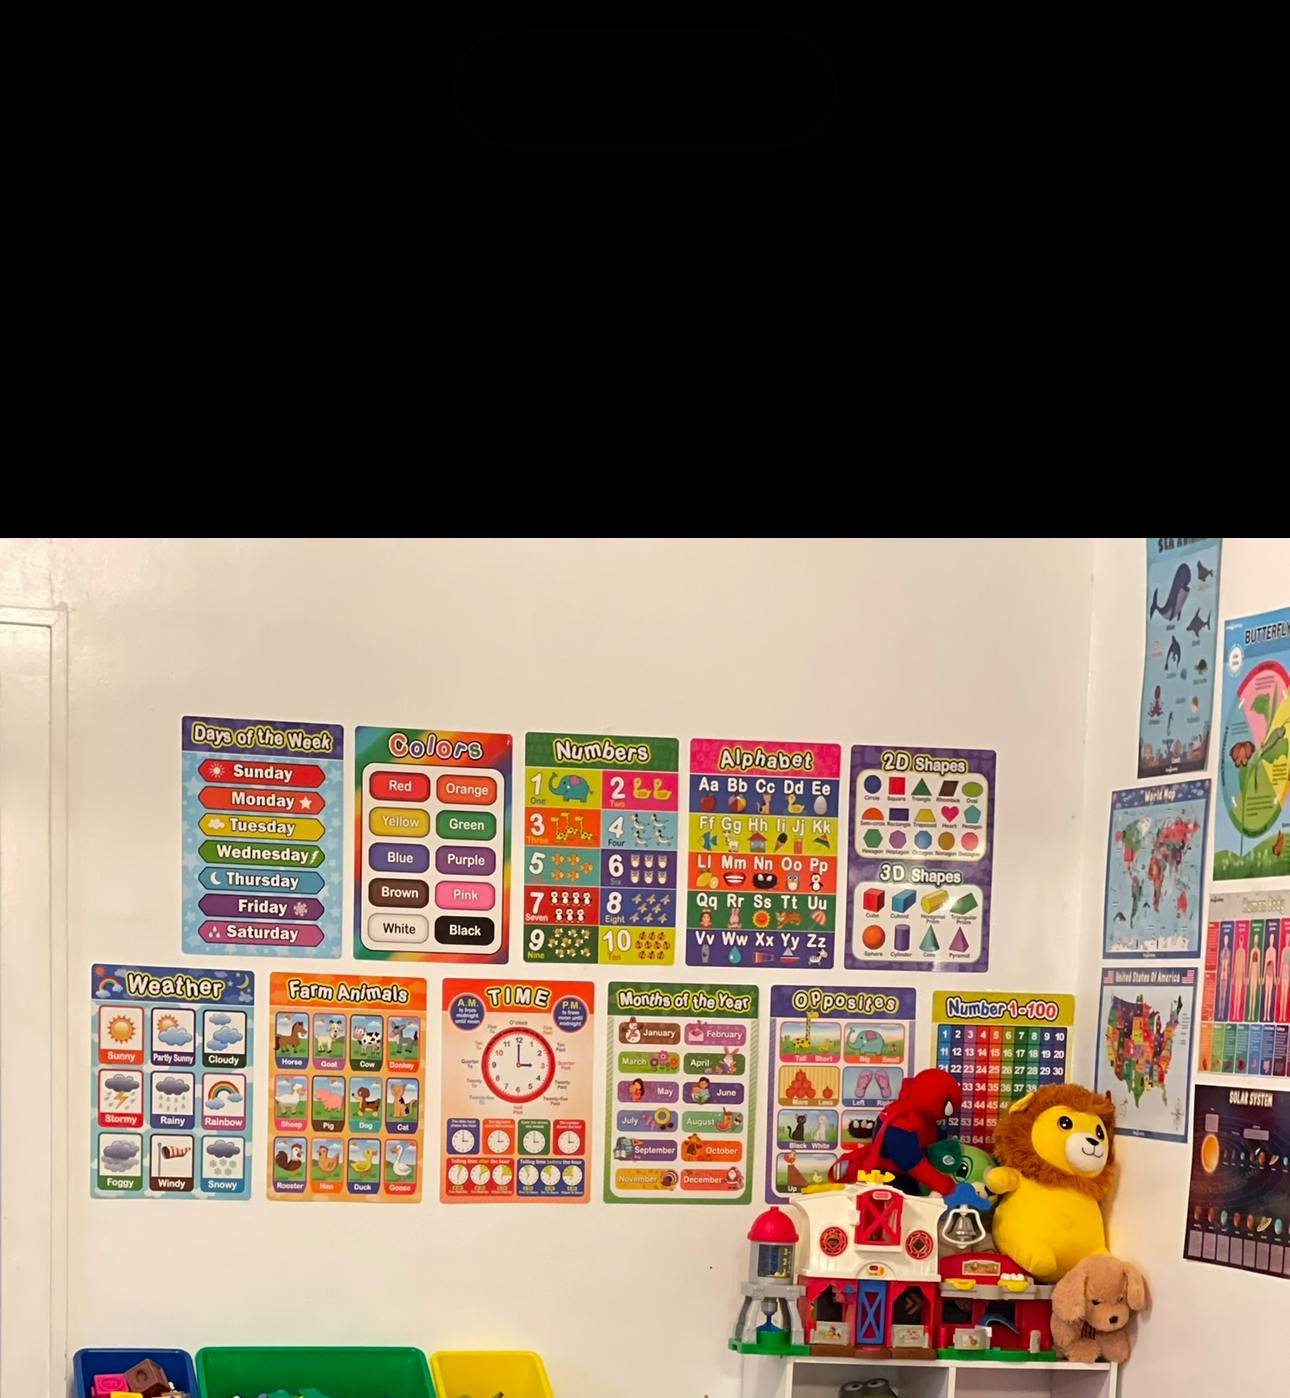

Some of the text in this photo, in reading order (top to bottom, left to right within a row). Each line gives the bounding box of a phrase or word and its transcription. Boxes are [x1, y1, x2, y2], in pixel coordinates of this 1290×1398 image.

[193, 724, 332, 752] Days of the Week
[389, 733, 482, 759] Colors
[555, 740, 649, 762] Numbers
[720, 747, 814, 770] Alphabet
[882, 752, 966, 774] 2D Shapes
[233, 764, 292, 783] Sunday
[388, 780, 412, 792] Red
[445, 783, 488, 796] Orange
[531, 773, 541, 795] 1
[610, 776, 626, 800] 2
[699, 777, 831, 795] Aa Bb Cc Dd Ee
[232, 791, 294, 810] Monday
[1144, 789, 1175, 802] World Map
[229, 818, 295, 837] Tuesday
[382, 816, 420, 828] Yellow
[449, 818, 485, 831] Green
[530, 813, 545, 836] 3
[609, 816, 624, 839] 4
[700, 817, 831, 836] Ff Gg Hh Ii Jj Kk
[608, 839, 625, 848] Four
[216, 844, 308, 864] Wednesday
[387, 851, 414, 864] Blue
[447, 854, 485, 868] Purple
[529, 852, 546, 874] 5
[608, 854, 623, 877] 6
[698, 856, 828, 874] Ll Mm Nn Oo Pp
[227, 872, 299, 890] Thursday
[880, 864, 961, 886] 3D Shapes
[381, 887, 419, 899] Brown
[453, 889, 479, 901] Pink
[530, 892, 544, 914] 7
[607, 891, 622, 915] 8
[697, 893, 827, 910] Qq Rr Ss Tt Uu
[238, 900, 287, 917] Friday
[525, 913, 549, 922] Seven
[605, 915, 625, 924] Eight
[226, 925, 298, 943] Saturday
[383, 923, 416, 935] White
[449, 924, 481, 937] Black
[529, 929, 544, 951] 9
[603, 929, 631, 952] 10
[696, 931, 826, 950] Vv Ww Xx Yy Zz
[528, 951, 544, 959] Nine
[1116, 971, 1180, 983] United States Of America
[127, 973, 223, 998] Weather
[288, 980, 409, 1003] Farm Animals
[457, 999, 479, 1007] A.M.
[487, 987, 550, 1008] TIME
[619, 990, 750, 1011] Months of the Year
[793, 990, 898, 1013] Opposites
[562, 1001, 582, 1009] P.M.
[947, 998, 1058, 1021] Number 1-100
[643, 1029, 676, 1038] January
[707, 1030, 743, 1040] February
[955, 1030, 961, 1038] 2
[967, 1031, 973, 1039] 3
[980, 1031, 986, 1039] 4
[993, 1031, 999, 1039] 5
[1006, 1031, 1011, 1039] 6
[1019, 1032, 1025, 1040] 7
[1031, 1032, 1037, 1040] 8
[1054, 1033, 1065, 1041] 10
[107, 1052, 136, 1062] Sunny
[153, 1053, 193, 1064] Partly Sunny
[208, 1055, 239, 1066] Cloudy
[281, 1058, 302, 1066] Horse
[690, 1059, 710, 1068] April
[320, 1060, 338, 1068] Goat
[389, 1061, 414, 1070] Donkey
[657, 1087, 674, 1097] May
[716, 1088, 736, 1096] June
[1229, 1090, 1273, 1107] SOLAR SYSTEM
[105, 1115, 137, 1125] Stormy
[160, 1116, 185, 1126] Rainy
[205, 1118, 242, 1127] Rainbow
[323, 1122, 334, 1131] Pig
[358, 1122, 373, 1130] Dog
[622, 1117, 639, 1126] July
[686, 1117, 714, 1127] August
[634, 1146, 676, 1155] September
[706, 1146, 738, 1155] October
[106, 1178, 134, 1188] Foggy
[158, 1179, 185, 1189] Windy
[208, 1180, 237, 1191] Snowy
[618, 1175, 657, 1183] November
[683, 1176, 722, 1184] December
[277, 1182, 304, 1190] Rooster
[787, 1185, 797, 1193] Up
